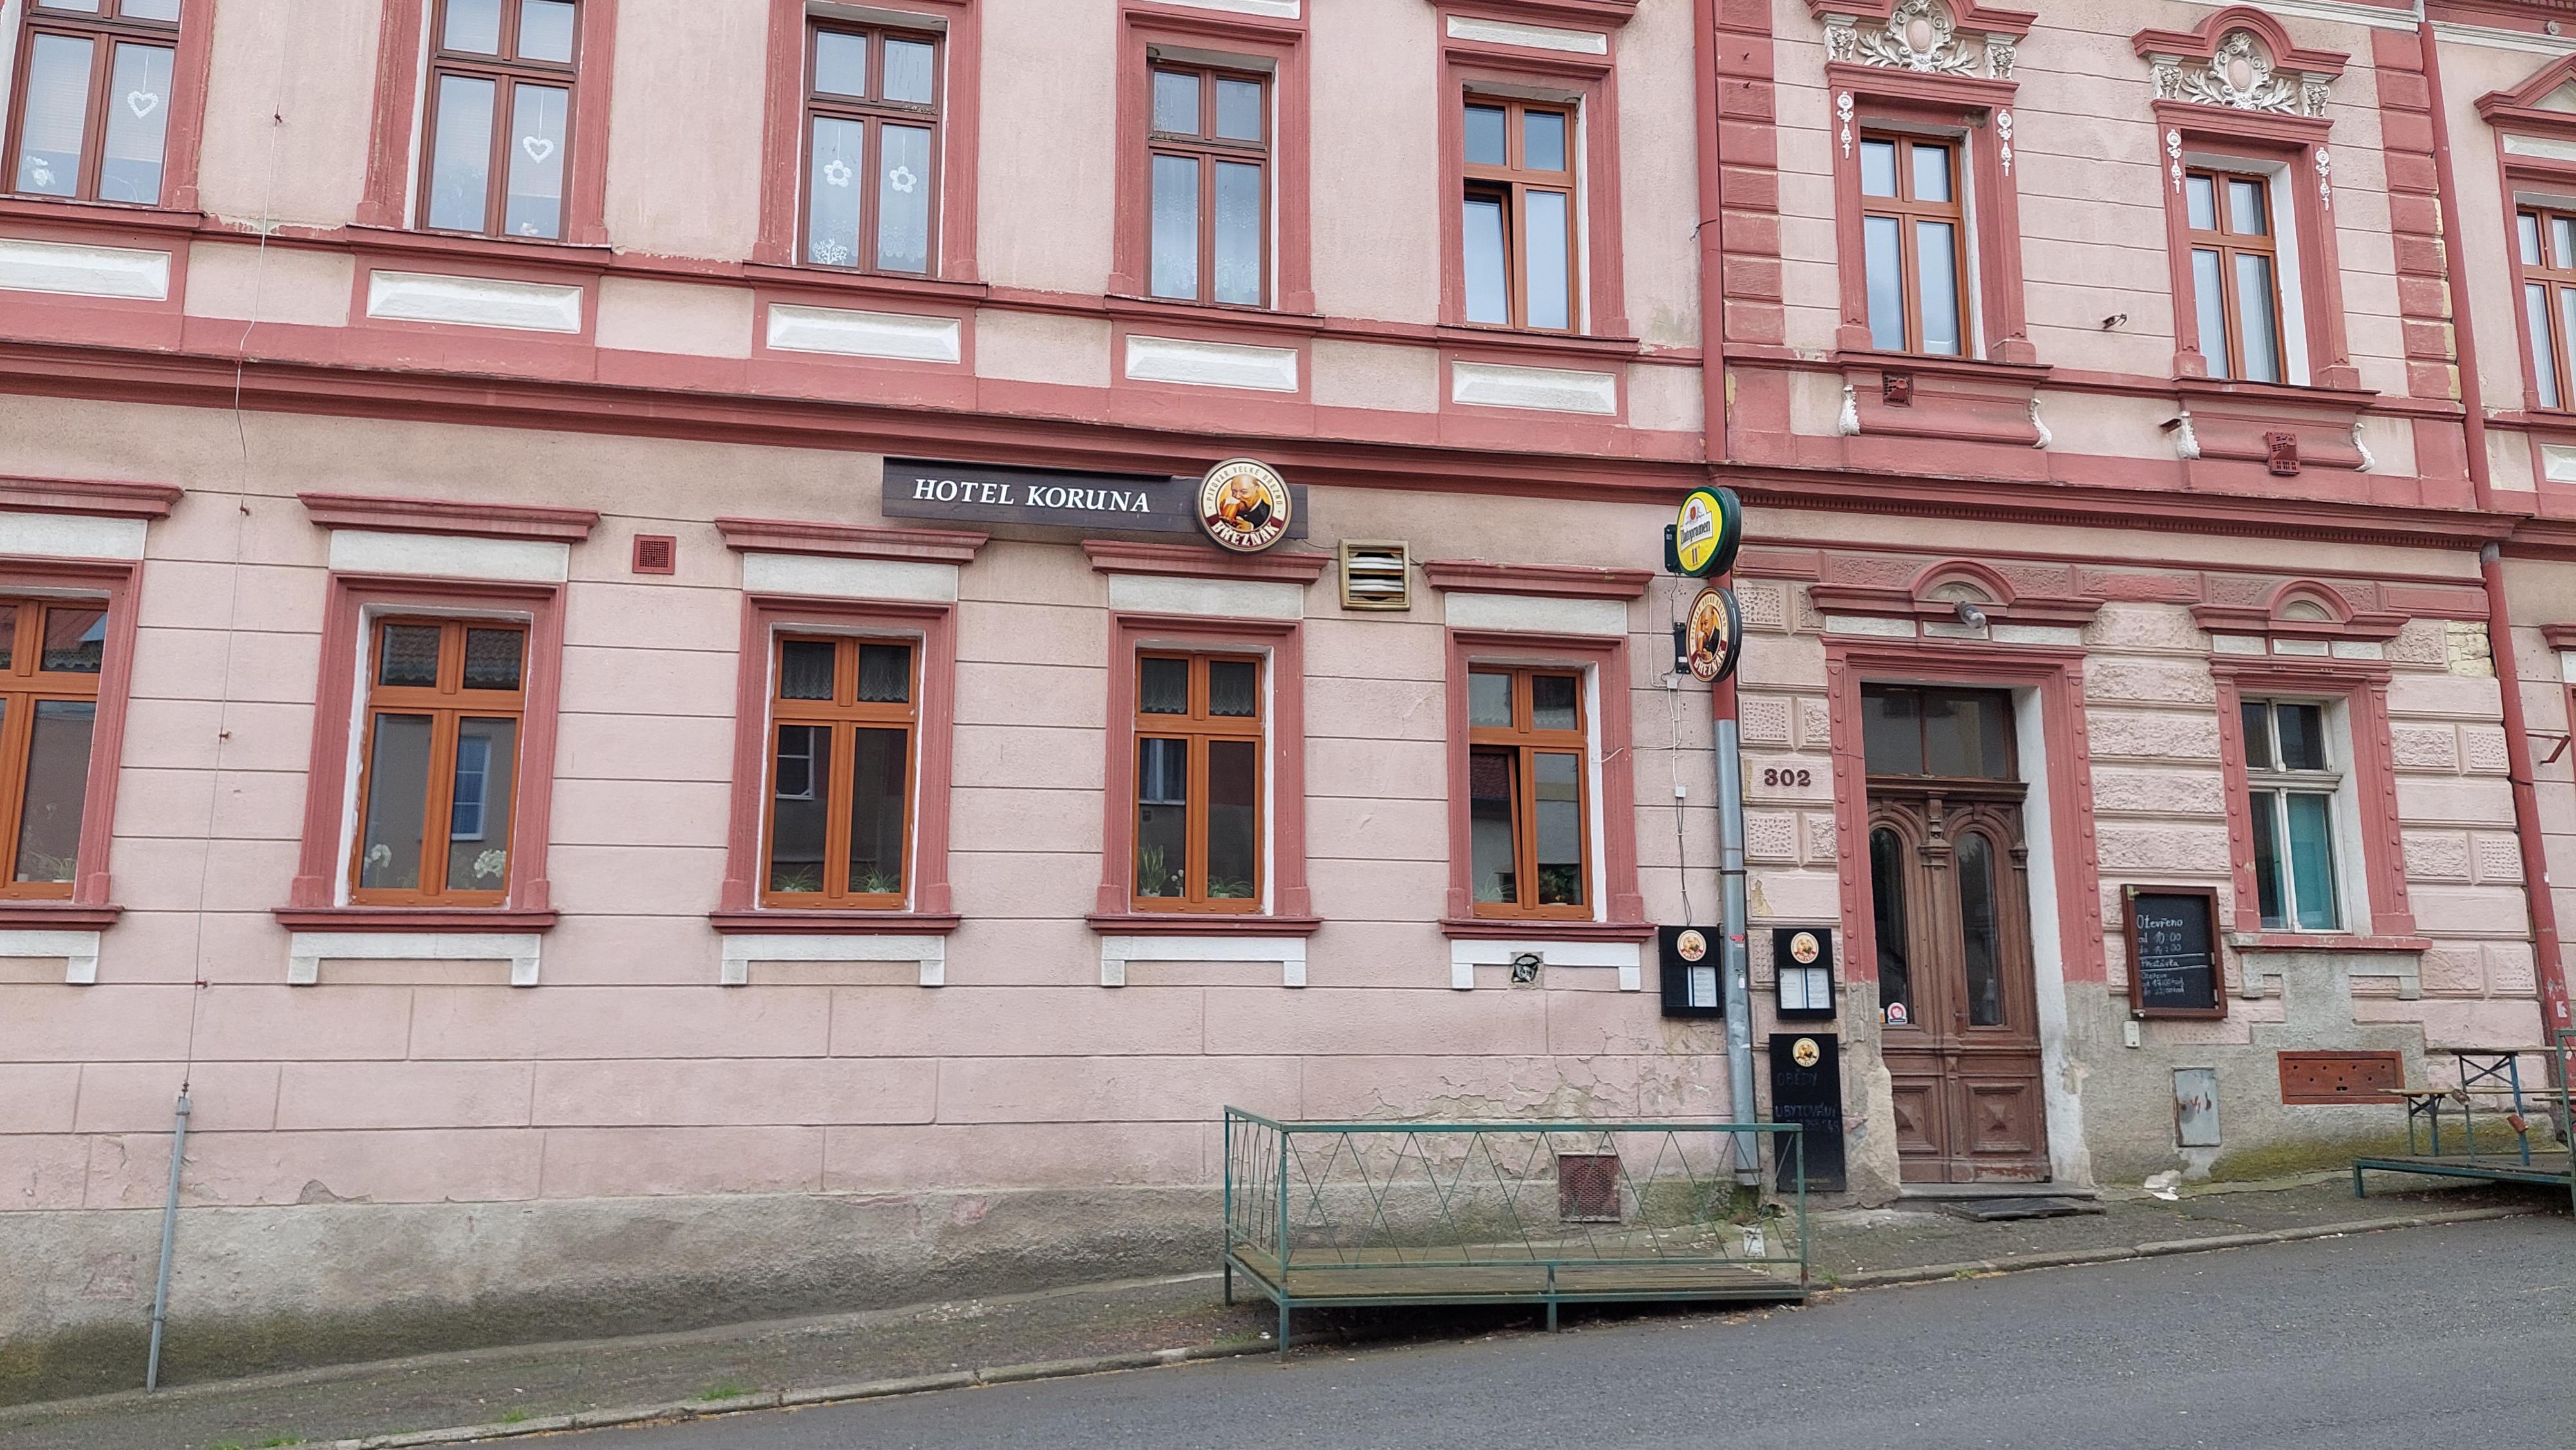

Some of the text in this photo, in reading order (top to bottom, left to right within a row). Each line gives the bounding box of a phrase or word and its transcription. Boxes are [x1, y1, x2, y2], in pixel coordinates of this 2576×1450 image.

[913, 479, 1150, 513] HOTEL KORUNA
[1206, 466, 1283, 505] PIVOVAR VELKÉ BŘEZNO
[1765, 768, 1811, 786] 302
